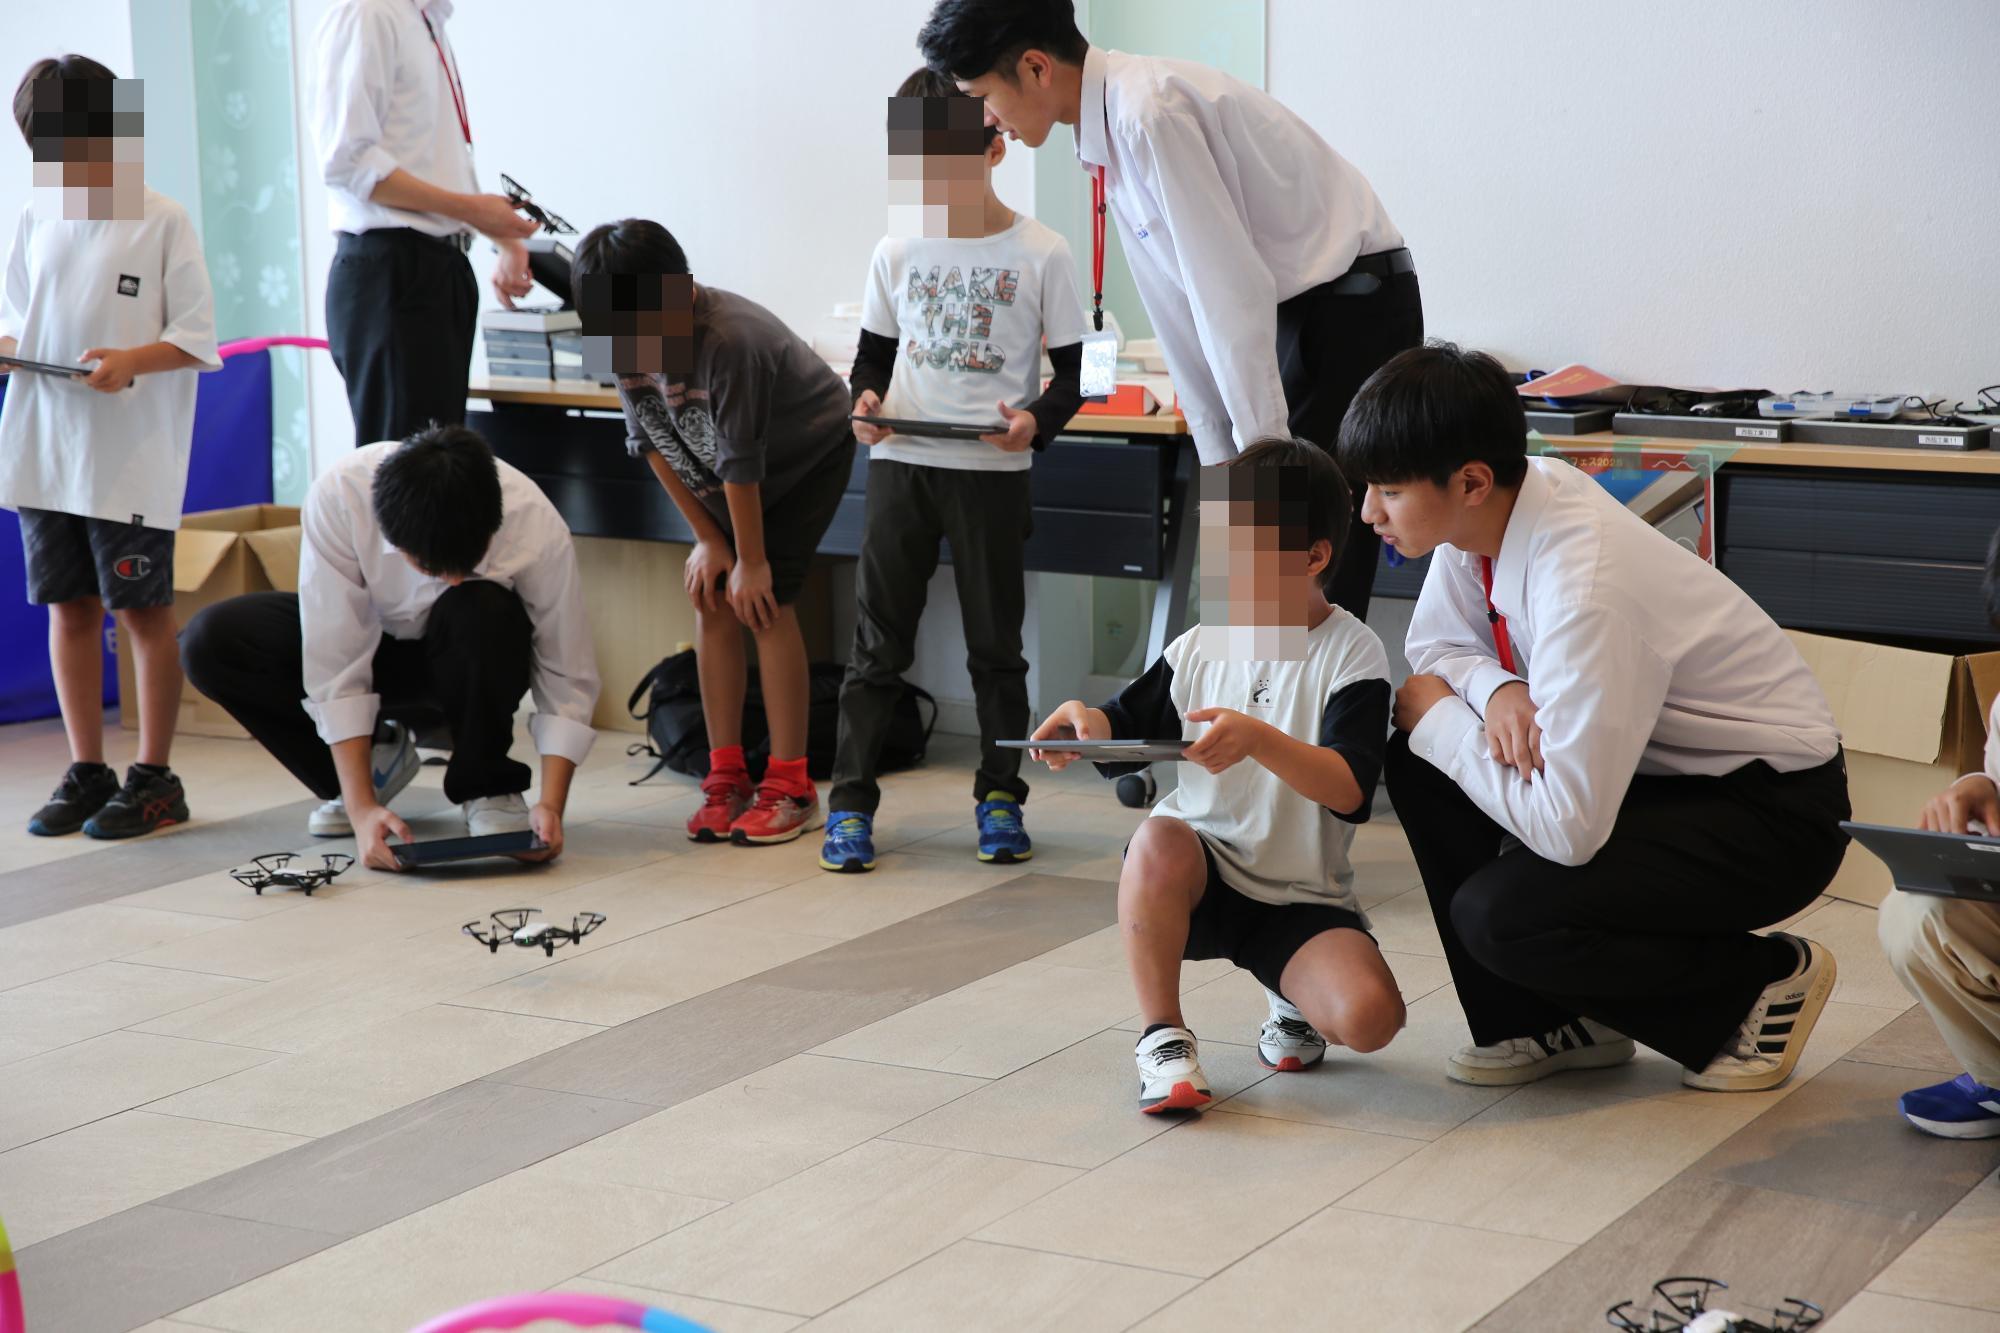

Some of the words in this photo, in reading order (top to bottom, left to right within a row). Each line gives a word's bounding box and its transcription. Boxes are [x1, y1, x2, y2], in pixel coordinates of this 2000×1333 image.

[907, 265, 1020, 307] MAKE
[921, 303, 995, 340] THE
[906, 338, 1007, 374] WORLD
